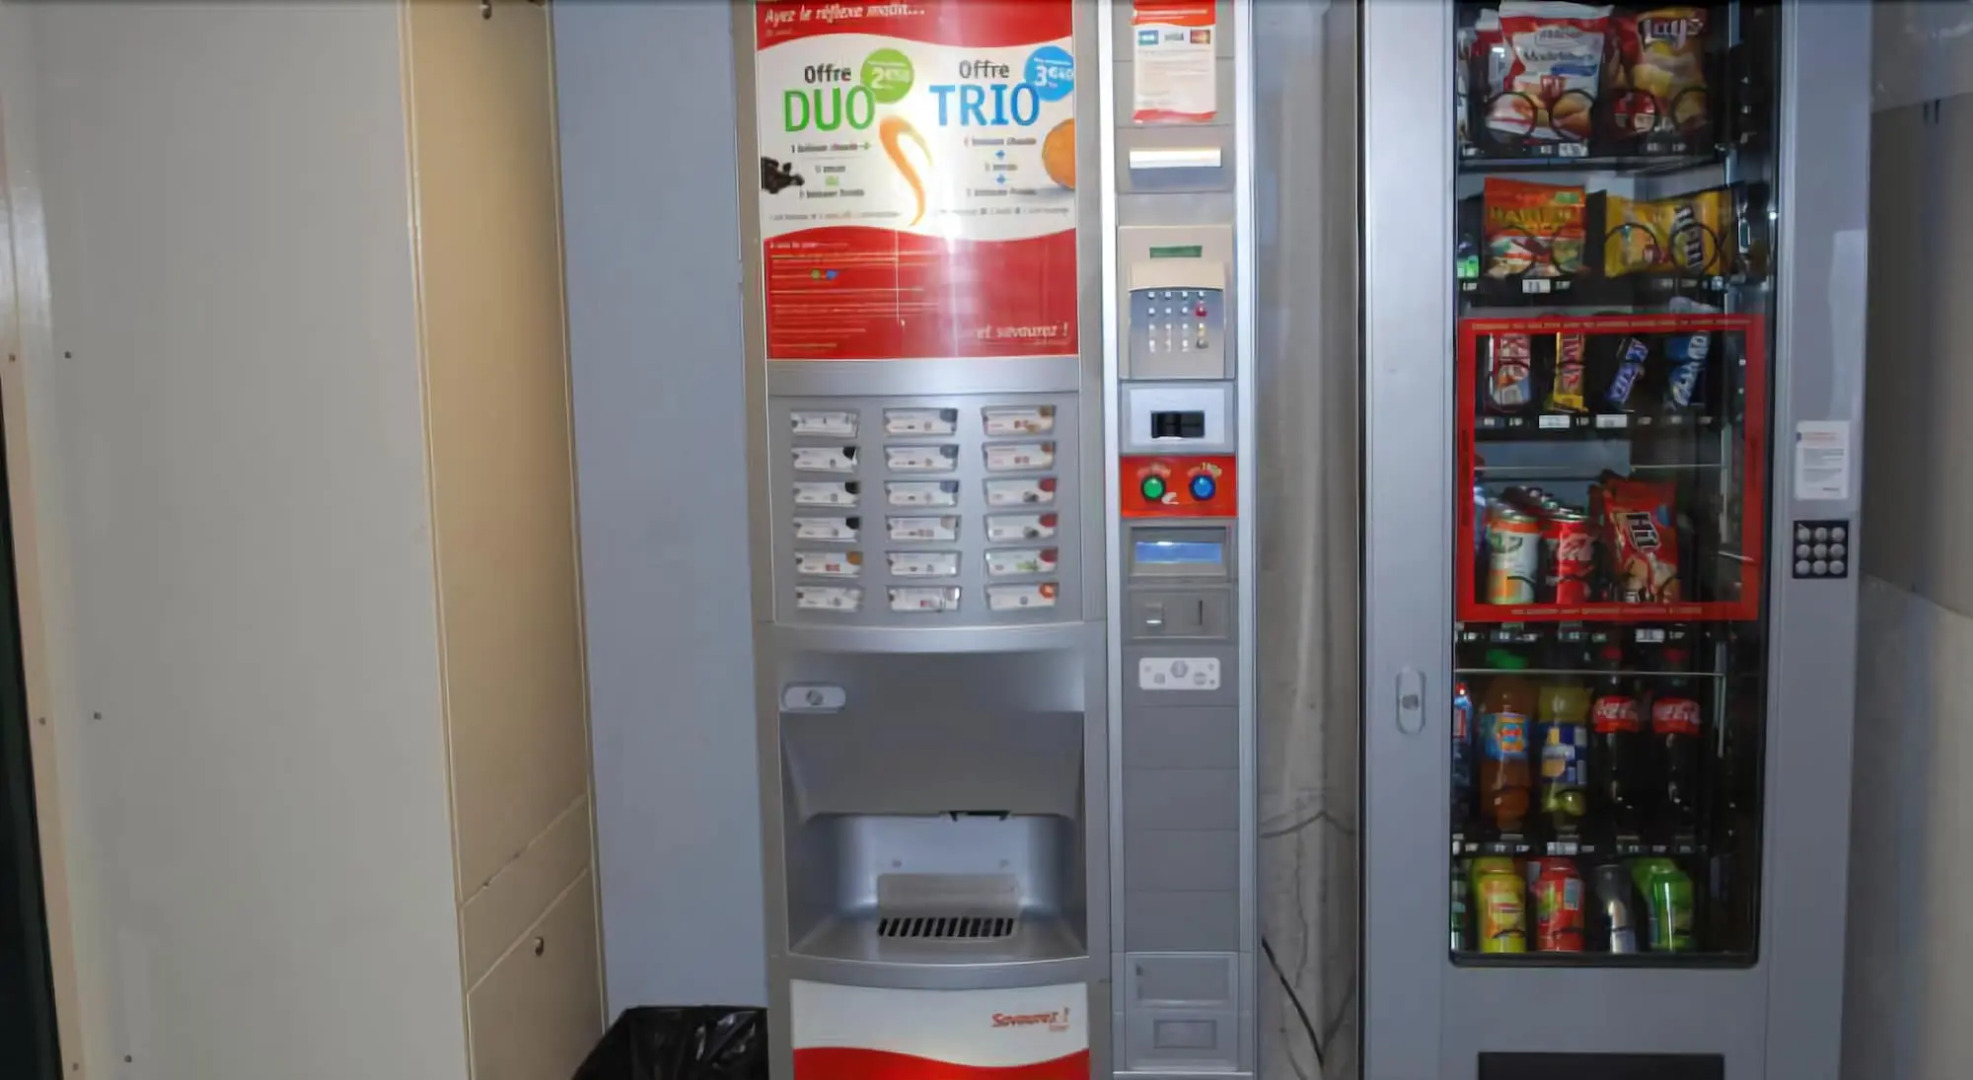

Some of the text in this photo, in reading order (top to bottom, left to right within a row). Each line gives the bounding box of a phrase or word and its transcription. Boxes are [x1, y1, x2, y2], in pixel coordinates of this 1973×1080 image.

[804, 63, 851, 83] Offre
[959, 60, 1010, 79] Offre
[784, 85, 875, 132] DUO
[929, 82, 1040, 127] TRIO
